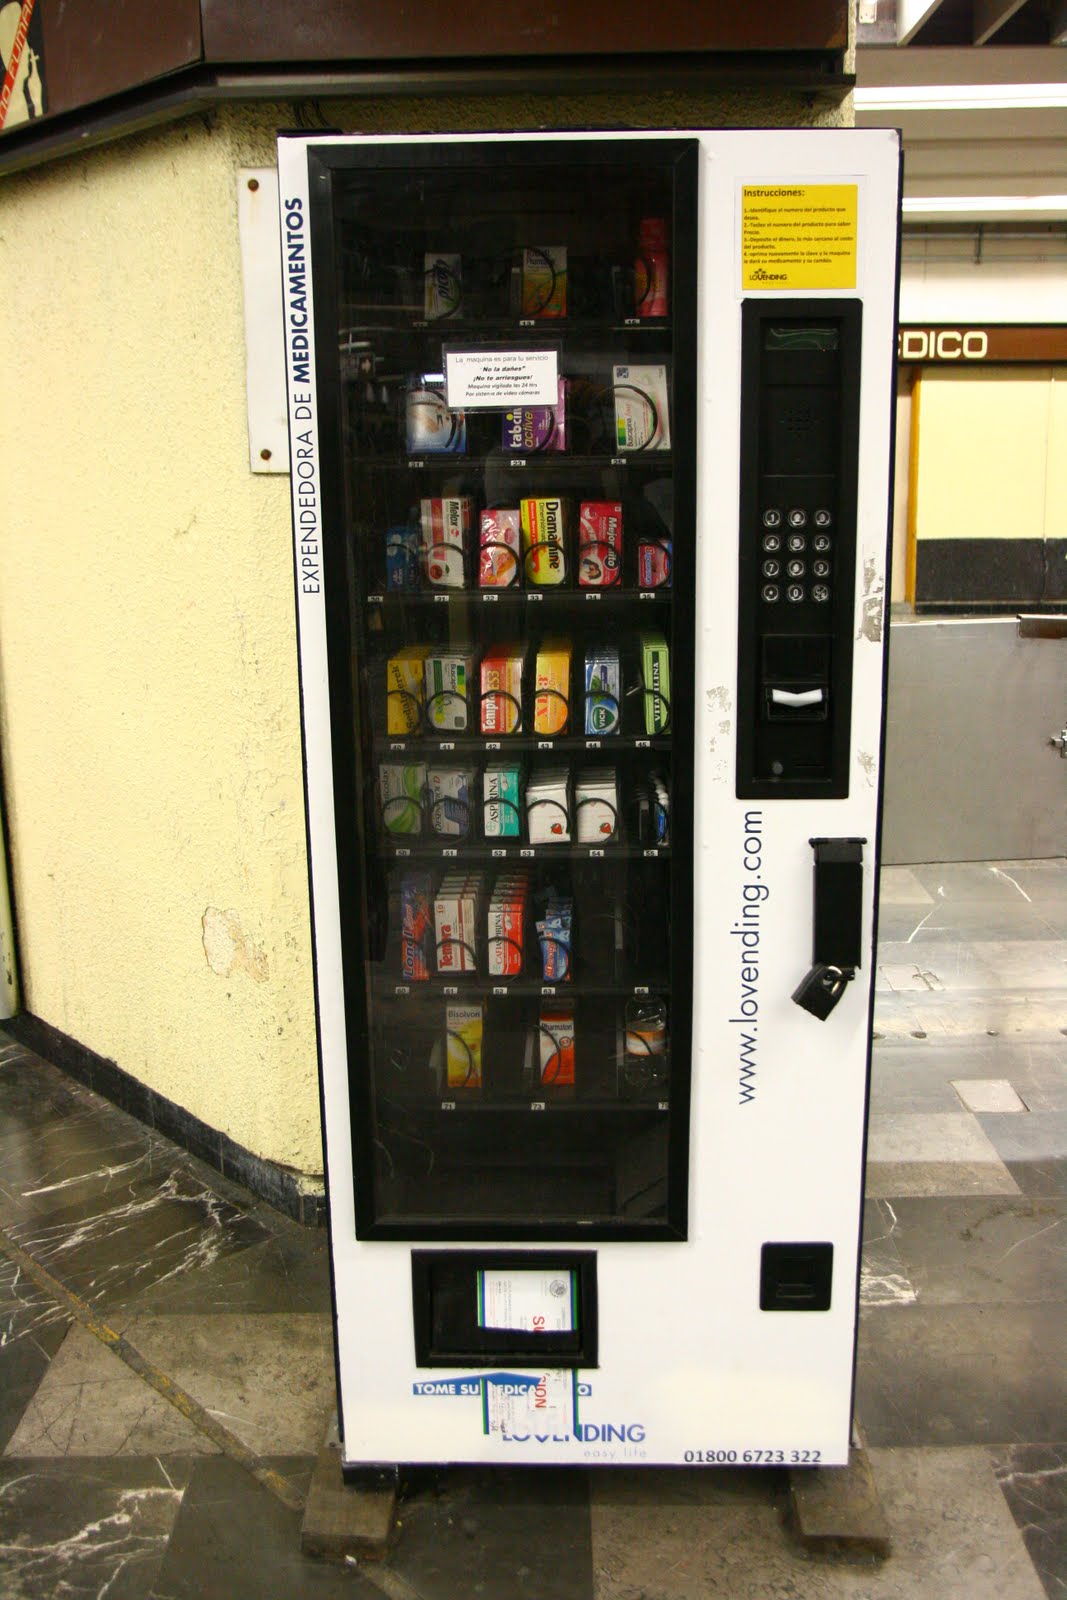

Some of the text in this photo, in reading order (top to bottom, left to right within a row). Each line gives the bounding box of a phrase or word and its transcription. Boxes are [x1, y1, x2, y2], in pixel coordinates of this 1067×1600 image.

[744, 189, 805, 197] Instrucciones:
[898, 331, 988, 359] DICO
[285, 197, 320, 594] EXPENDEDORA DE MEDICAMENTOS
[522, 412, 534, 447] active
[449, 501, 459, 526] Melox
[607, 517, 617, 566] Mejorlito
[483, 694, 498, 730] Tempra
[490, 778, 498, 823] ASPIRINA
[437, 905, 444, 914] 10
[440, 924, 452, 969] Temra
[728, 811, 770, 1106] www.lovending.com
[415, 1383, 456, 1395] TOME
[460, 1383, 479, 1395] SU
[584, 1449, 647, 1459] easy life
[684, 1450, 822, 1463] 01800 6723 322
